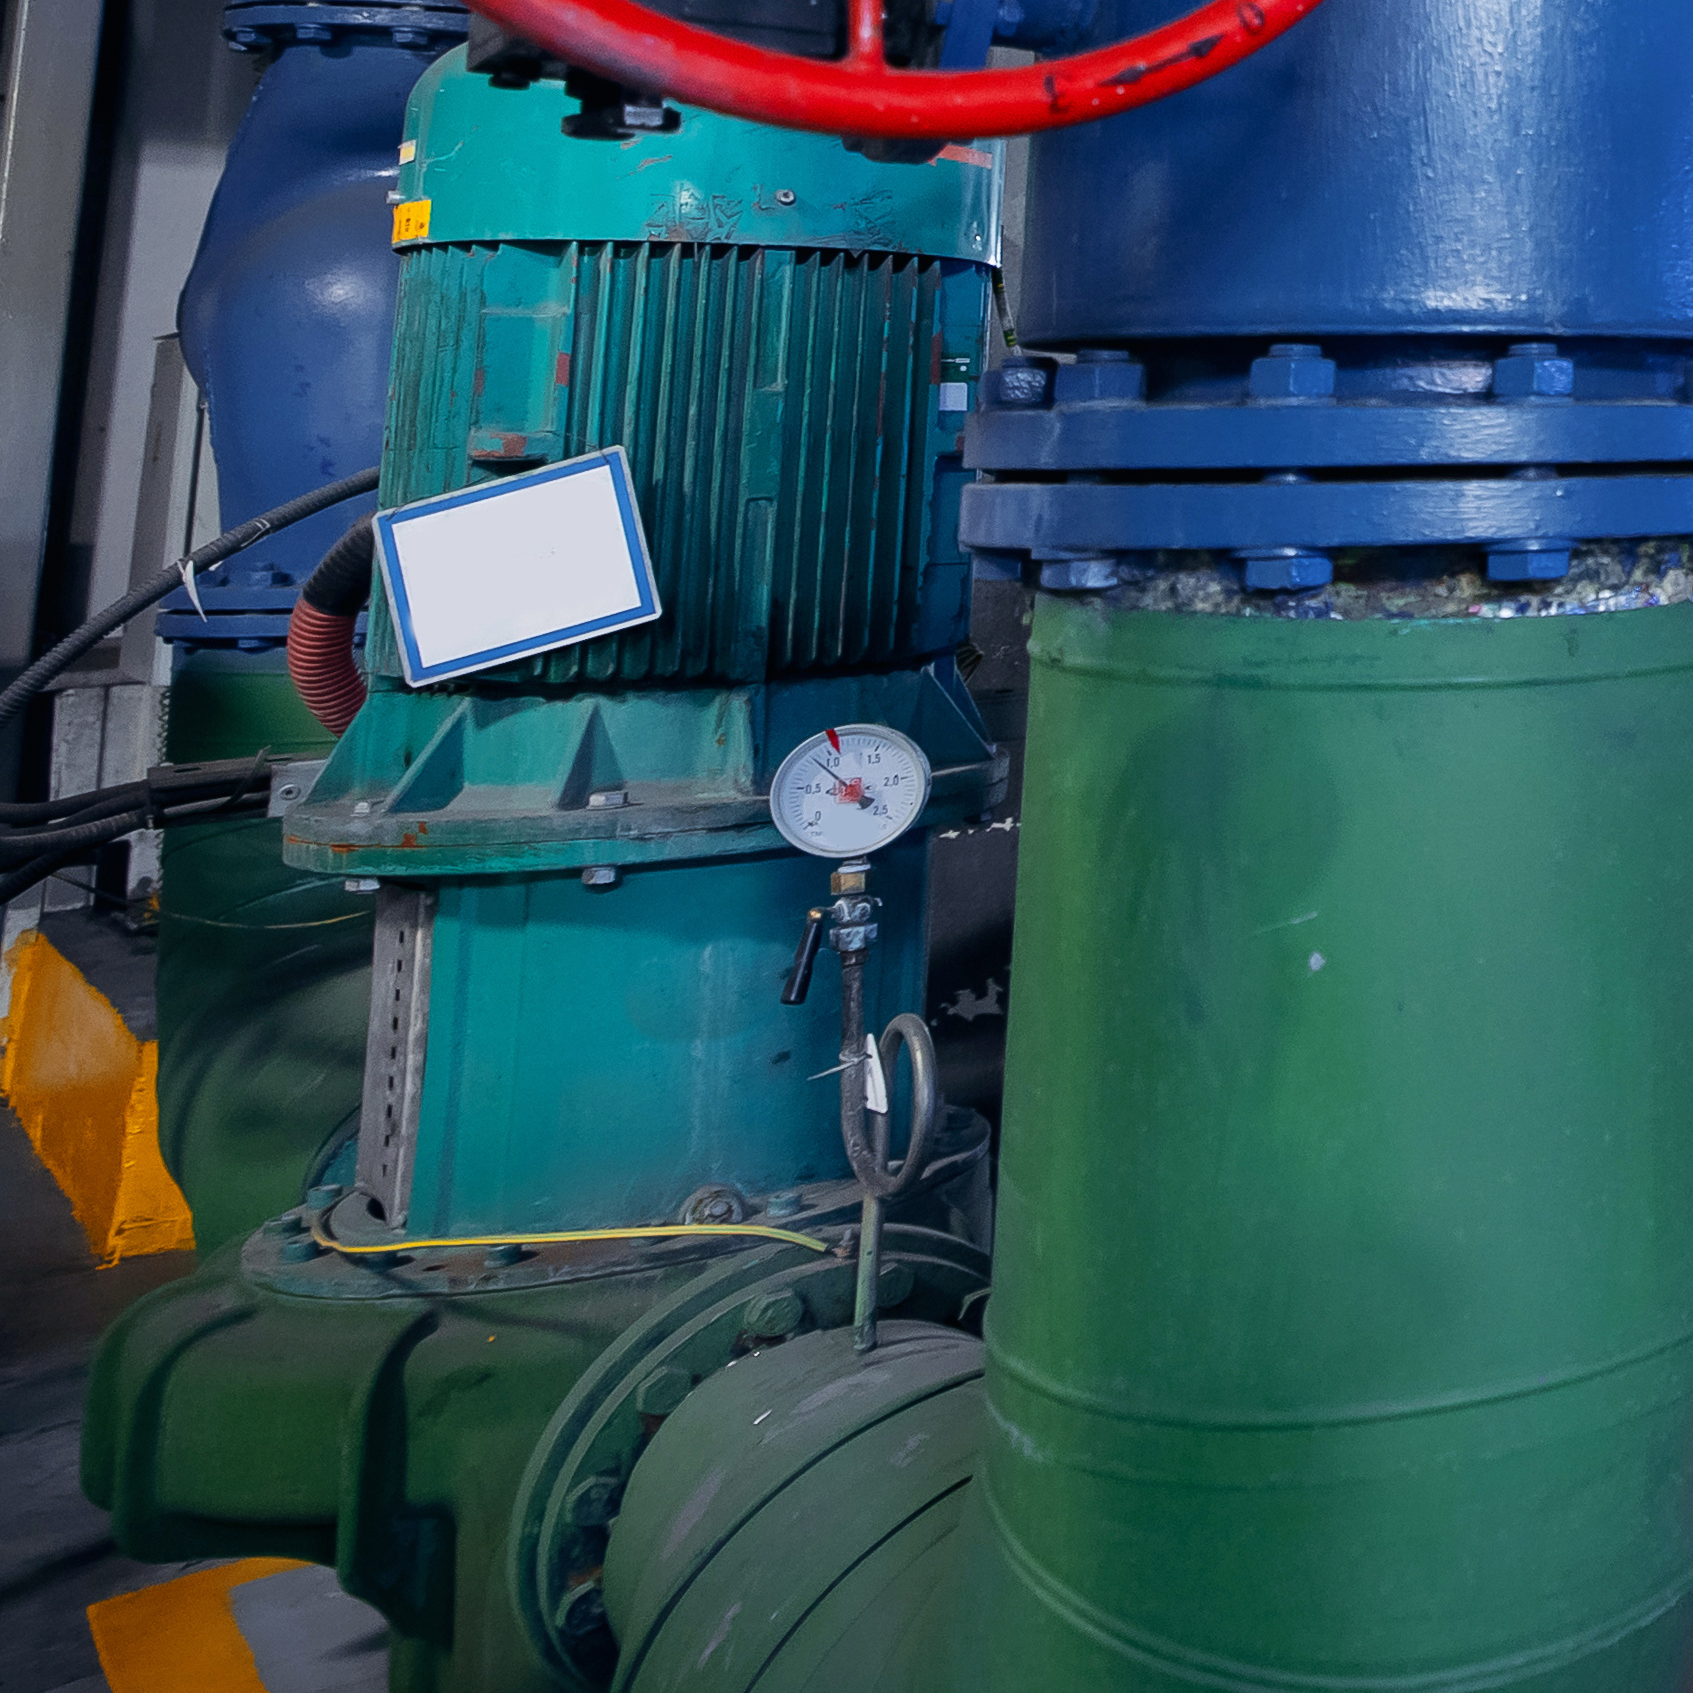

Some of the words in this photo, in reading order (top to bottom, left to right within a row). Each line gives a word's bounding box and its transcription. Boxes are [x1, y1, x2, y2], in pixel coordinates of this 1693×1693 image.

[826, 757, 840, 768] 1,0
[867, 754, 881, 764] 1,5
[884, 775, 899, 787] 2,0
[805, 783, 821, 795] 0,5
[815, 811, 821, 821] 0
